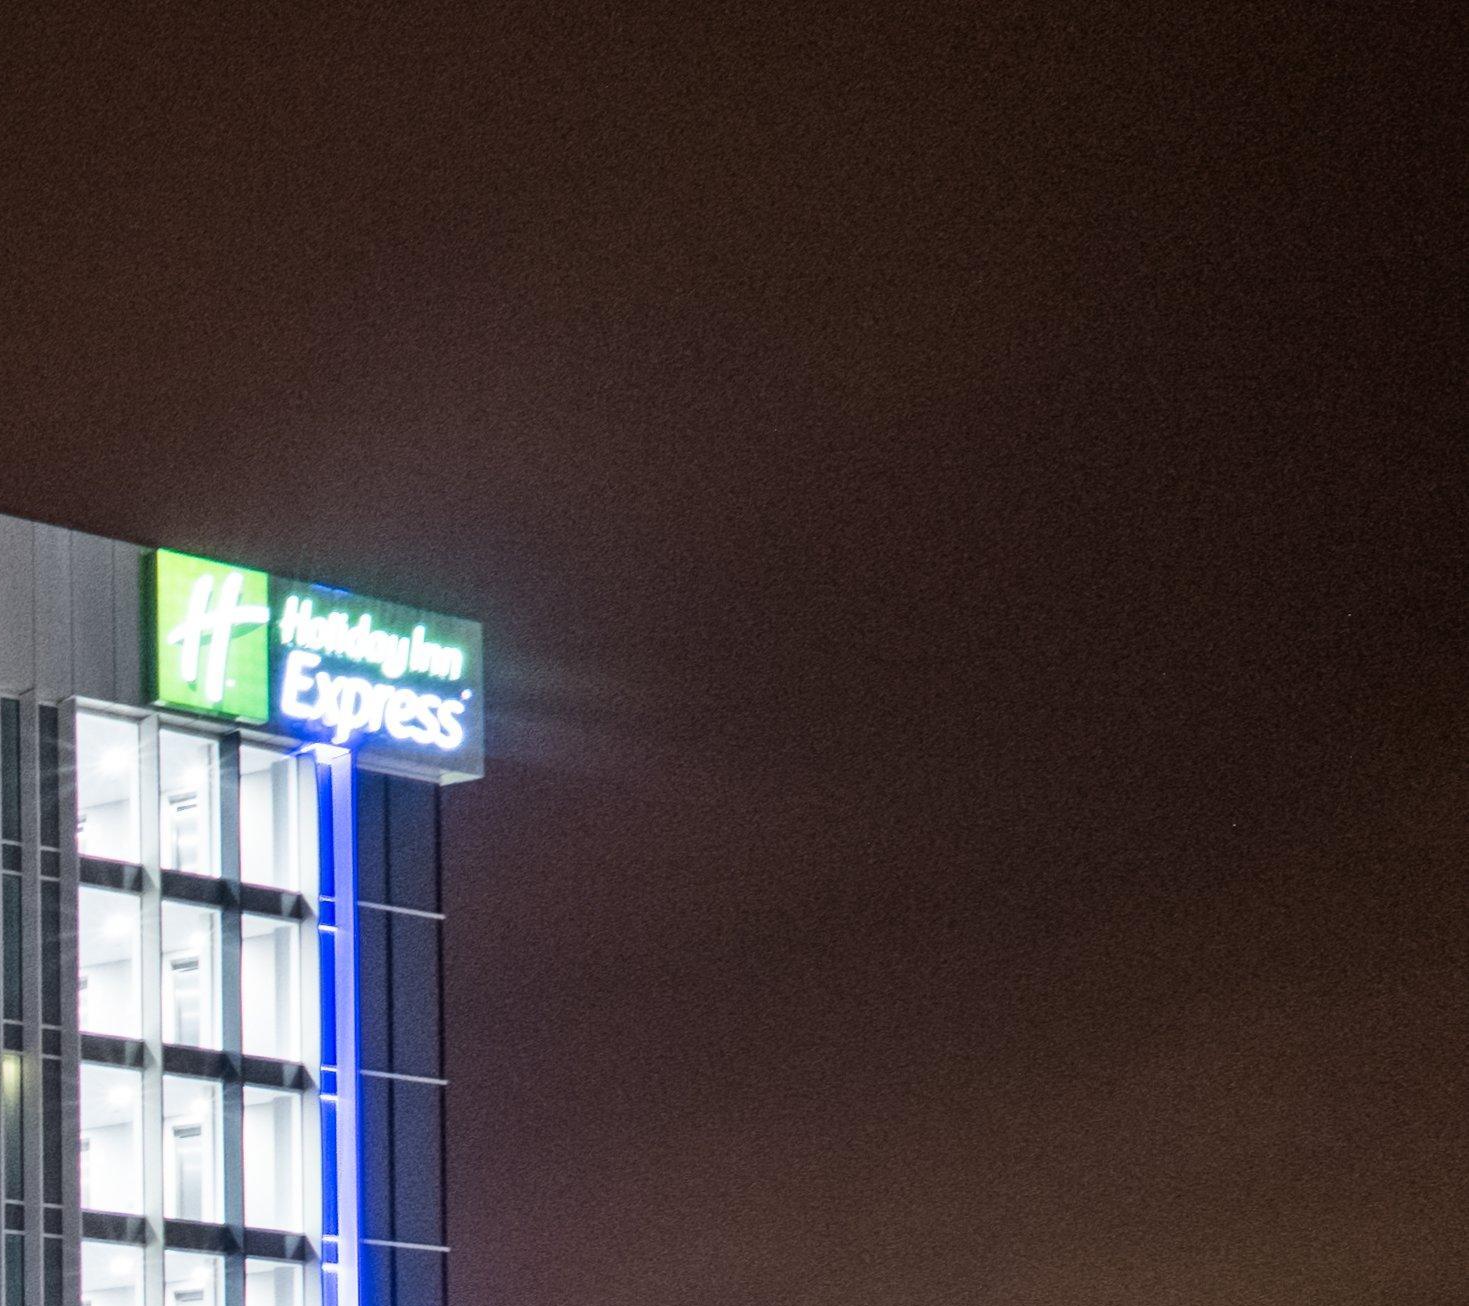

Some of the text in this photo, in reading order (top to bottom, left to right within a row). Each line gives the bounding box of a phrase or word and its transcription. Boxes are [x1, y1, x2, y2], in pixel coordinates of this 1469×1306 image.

[278, 595, 464, 681] Holiday Inn
[281, 650, 466, 750] Express
